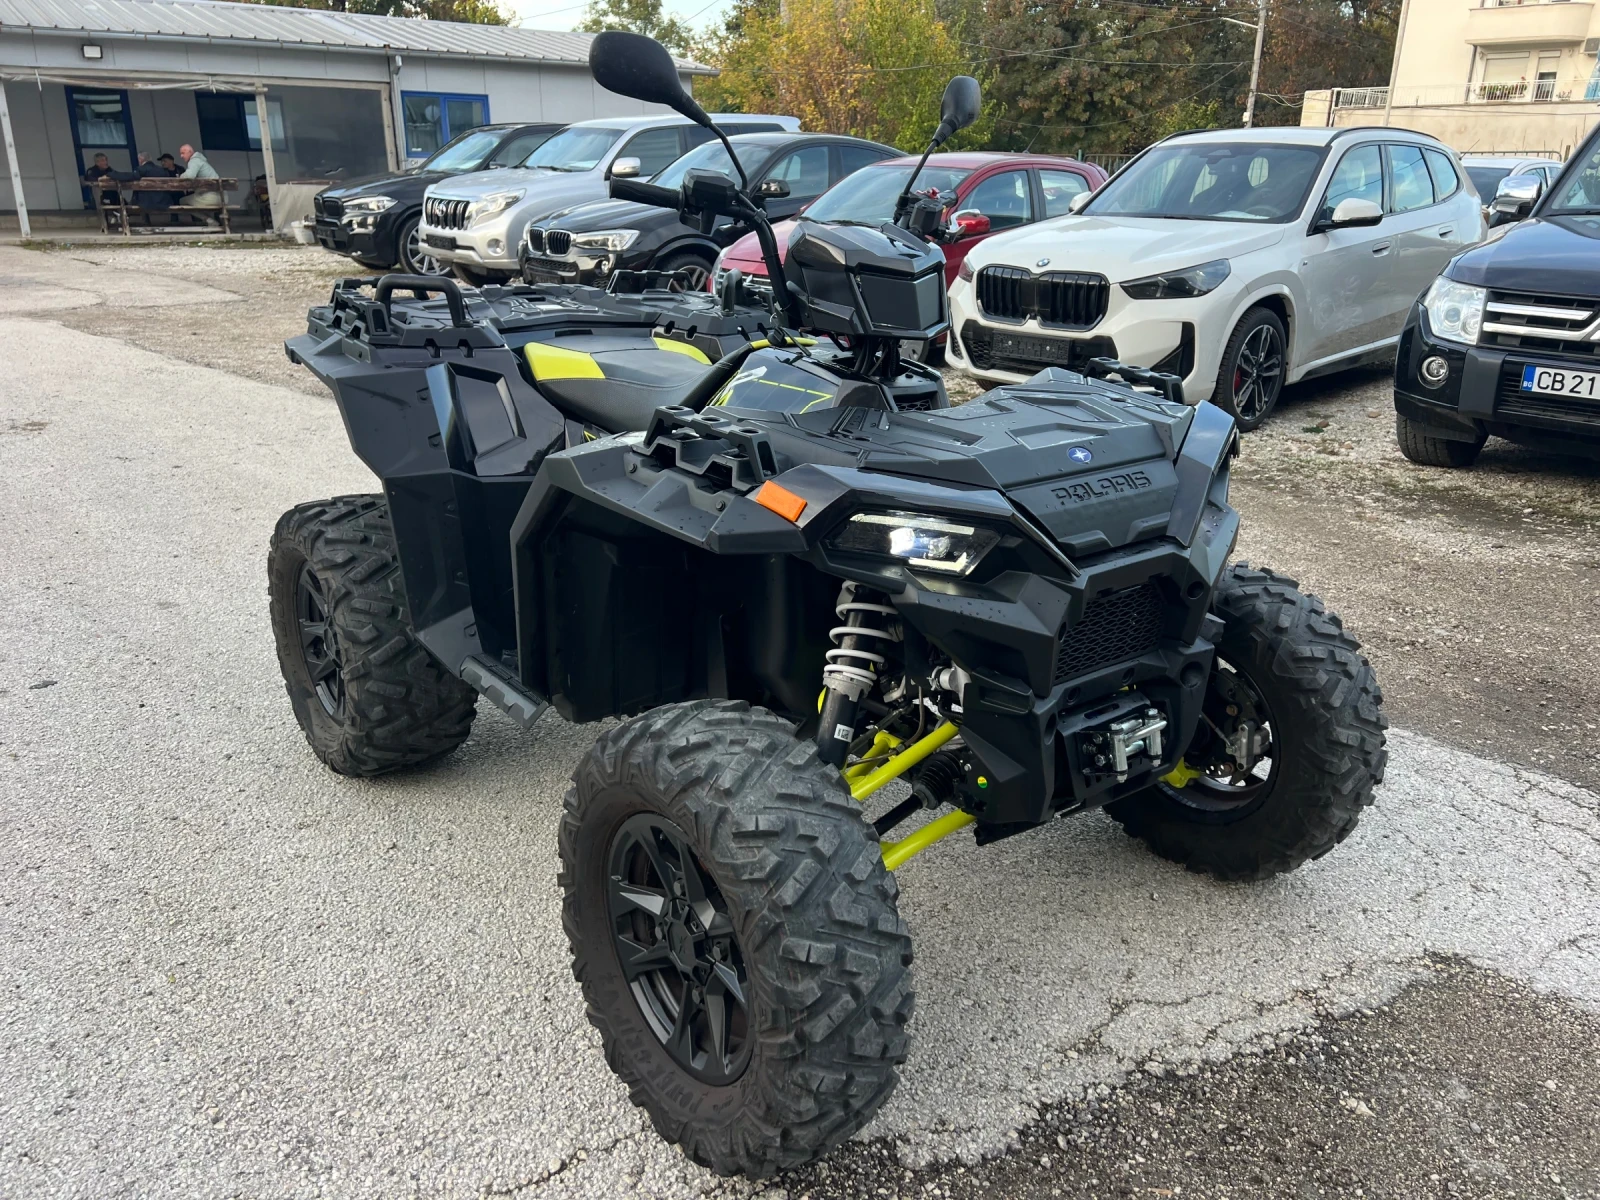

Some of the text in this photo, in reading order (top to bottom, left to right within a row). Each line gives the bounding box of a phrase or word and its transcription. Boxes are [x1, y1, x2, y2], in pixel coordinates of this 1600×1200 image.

[1537, 371, 1596, 395] CB 21
[1051, 471, 1152, 505] POLARIS
[647, 1064, 707, 1114] POWER
